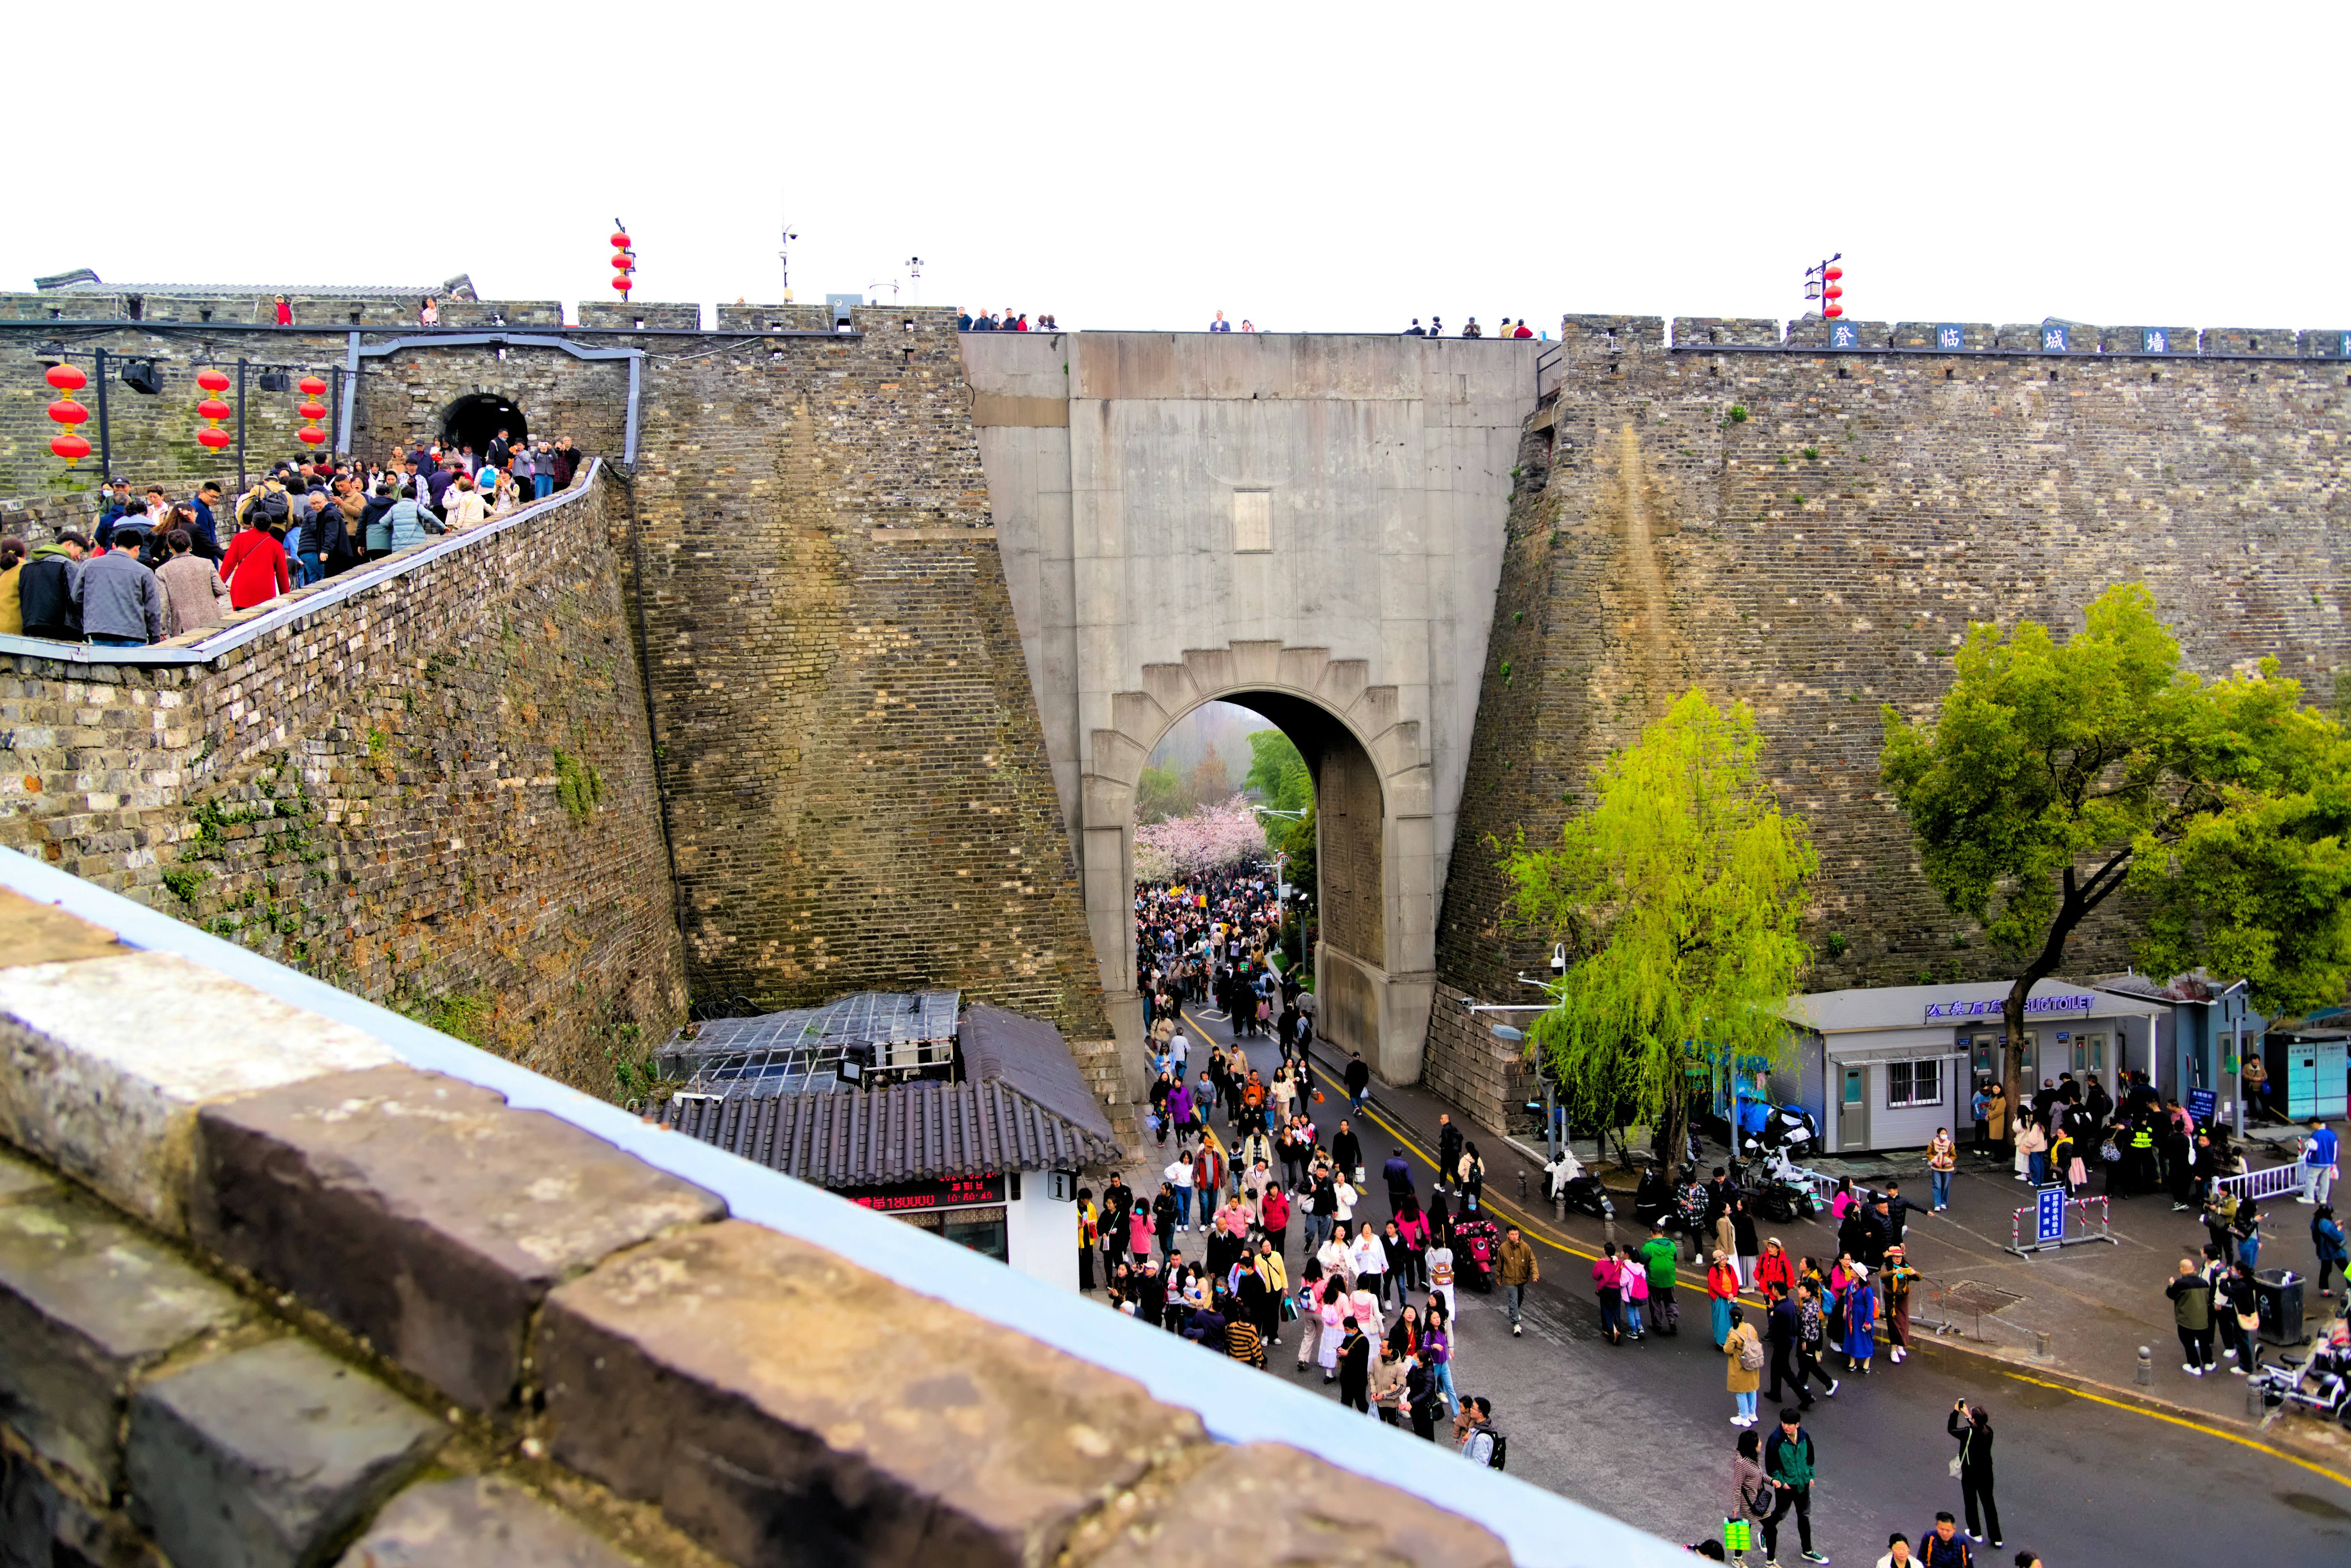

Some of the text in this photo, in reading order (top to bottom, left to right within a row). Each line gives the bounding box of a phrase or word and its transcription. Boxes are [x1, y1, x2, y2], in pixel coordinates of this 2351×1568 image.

[1928, 1000, 2002, 1016] 公共厕所
[2023, 995, 2095, 1012] BLIC TOILET
